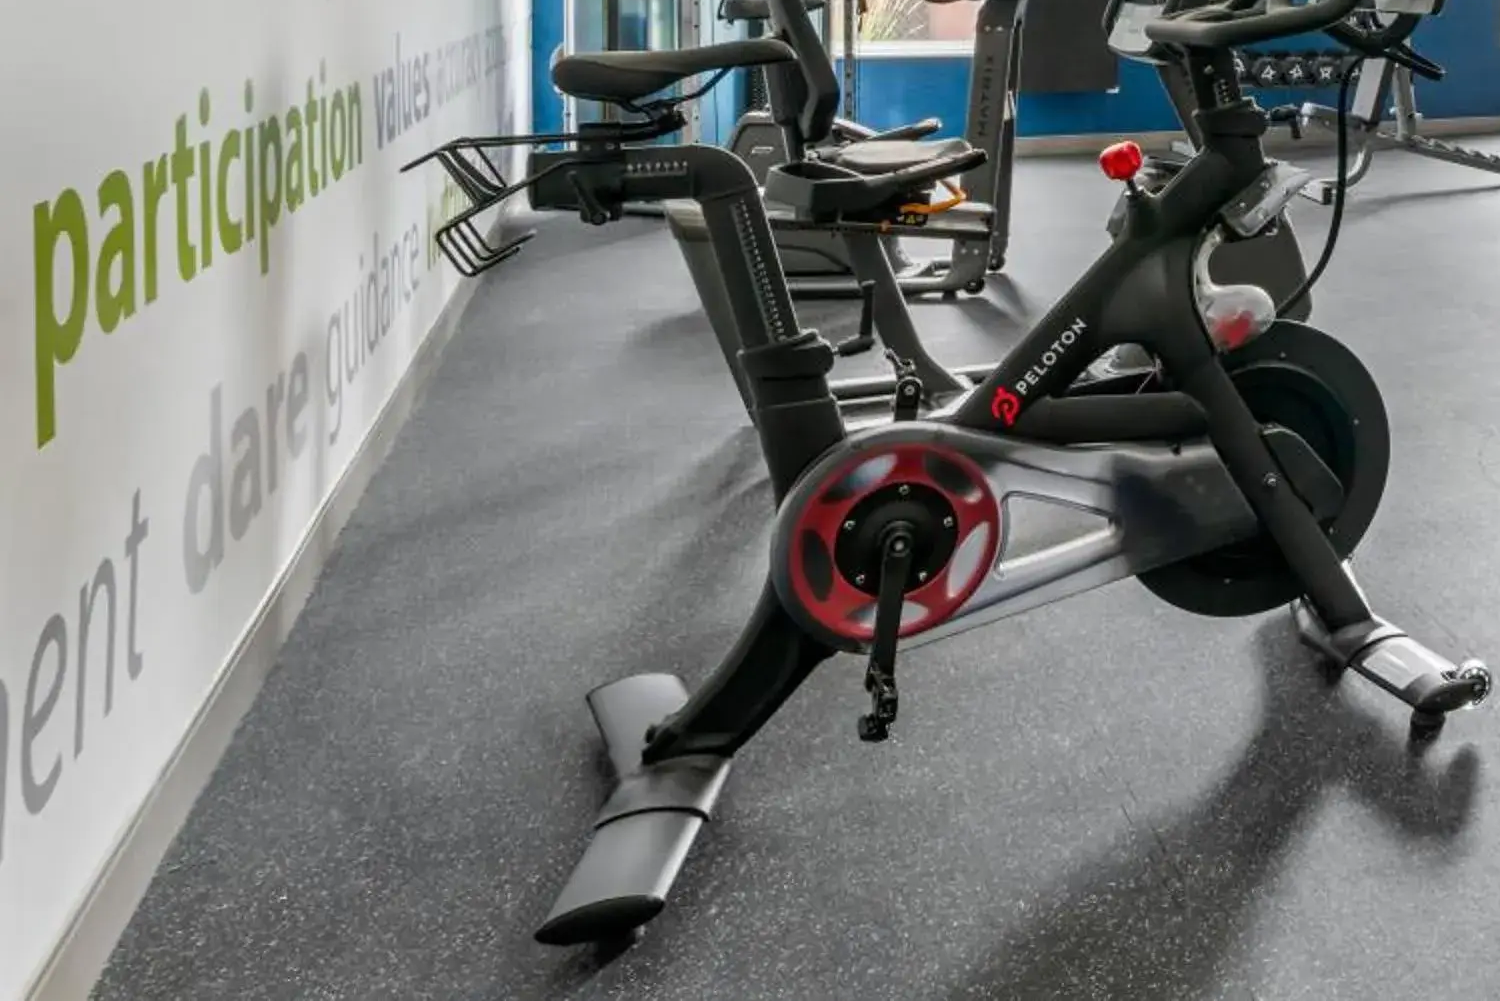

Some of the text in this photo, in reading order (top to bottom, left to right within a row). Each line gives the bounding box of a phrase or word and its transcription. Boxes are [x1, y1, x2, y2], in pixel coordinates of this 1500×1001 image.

[34, 58, 363, 450] participation
[373, 31, 430, 151] values
[183, 382, 309, 595] dare
[325, 223, 421, 446] guidance
[1015, 318, 1088, 395] PELOTON
